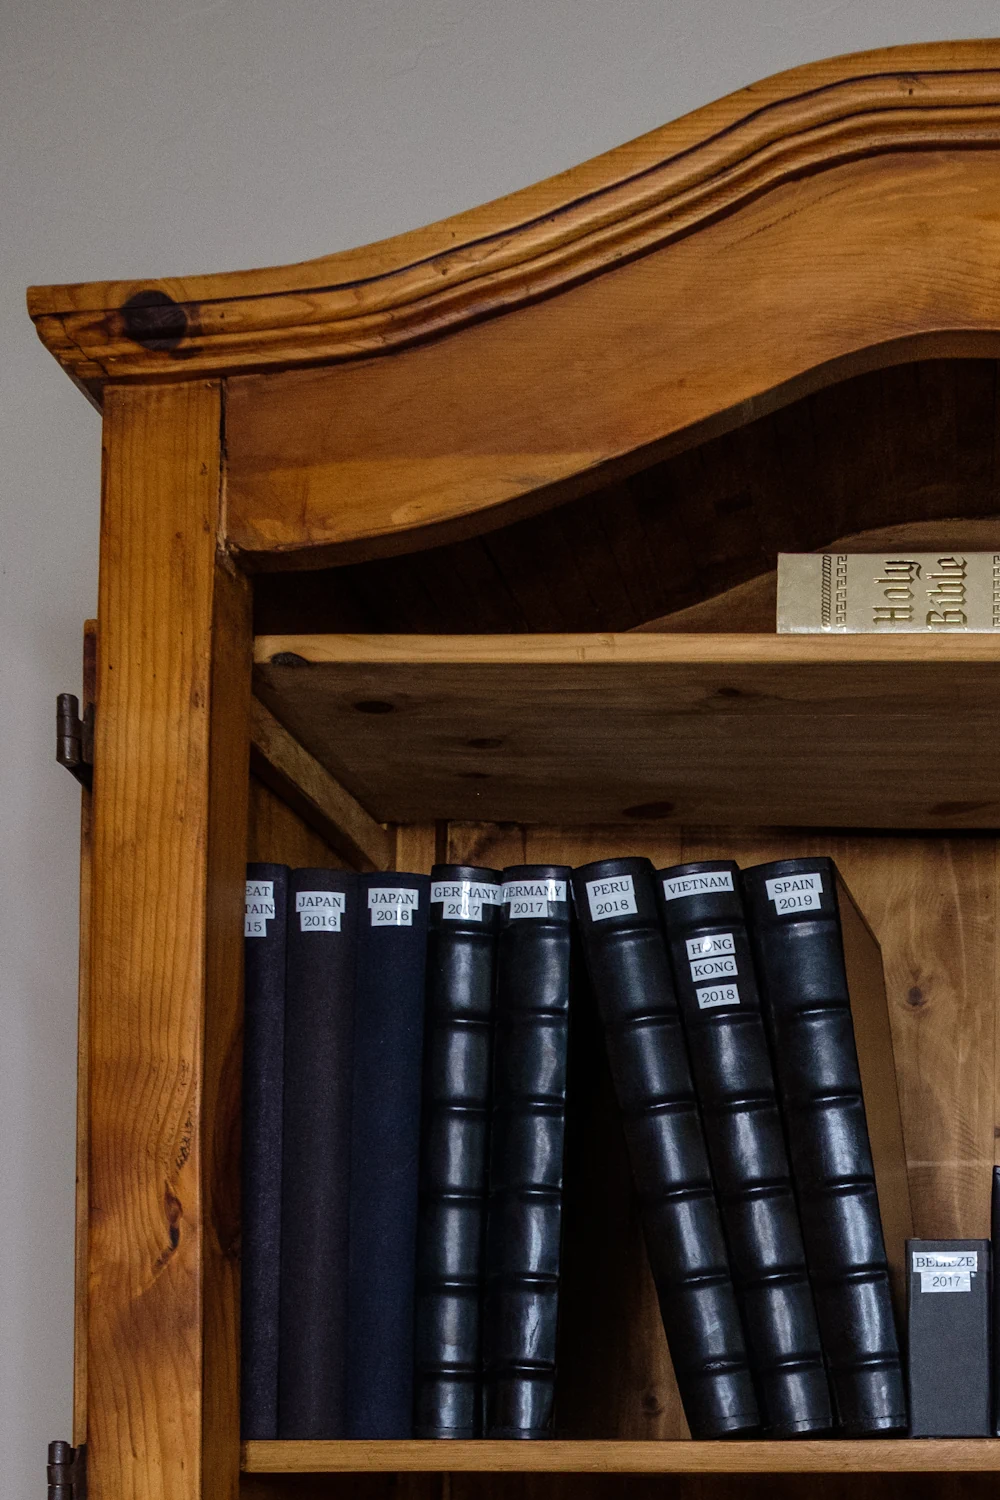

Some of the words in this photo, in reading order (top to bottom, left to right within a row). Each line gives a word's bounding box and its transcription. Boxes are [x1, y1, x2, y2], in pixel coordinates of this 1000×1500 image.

[872, 559, 922, 626] Holy
[926, 556, 968, 632] Bible
[502, 886, 562, 897] GERMANY
[592, 881, 630, 897] PERU
[668, 876, 730, 894] VIETNAM
[774, 879, 814, 894] SPAIN
[299, 897, 341, 908] JAPAN
[371, 893, 415, 905] JAPAN
[780, 895, 813, 910] 2019
[514, 903, 543, 914] 2017
[596, 899, 630, 915] 2018
[304, 916, 337, 927] 2016
[376, 910, 409, 921] 2016
[691, 939, 733, 955] HONG
[694, 961, 735, 977] KONG
[702, 990, 735, 1004] 2018
[932, 1276, 961, 1287] 2017
